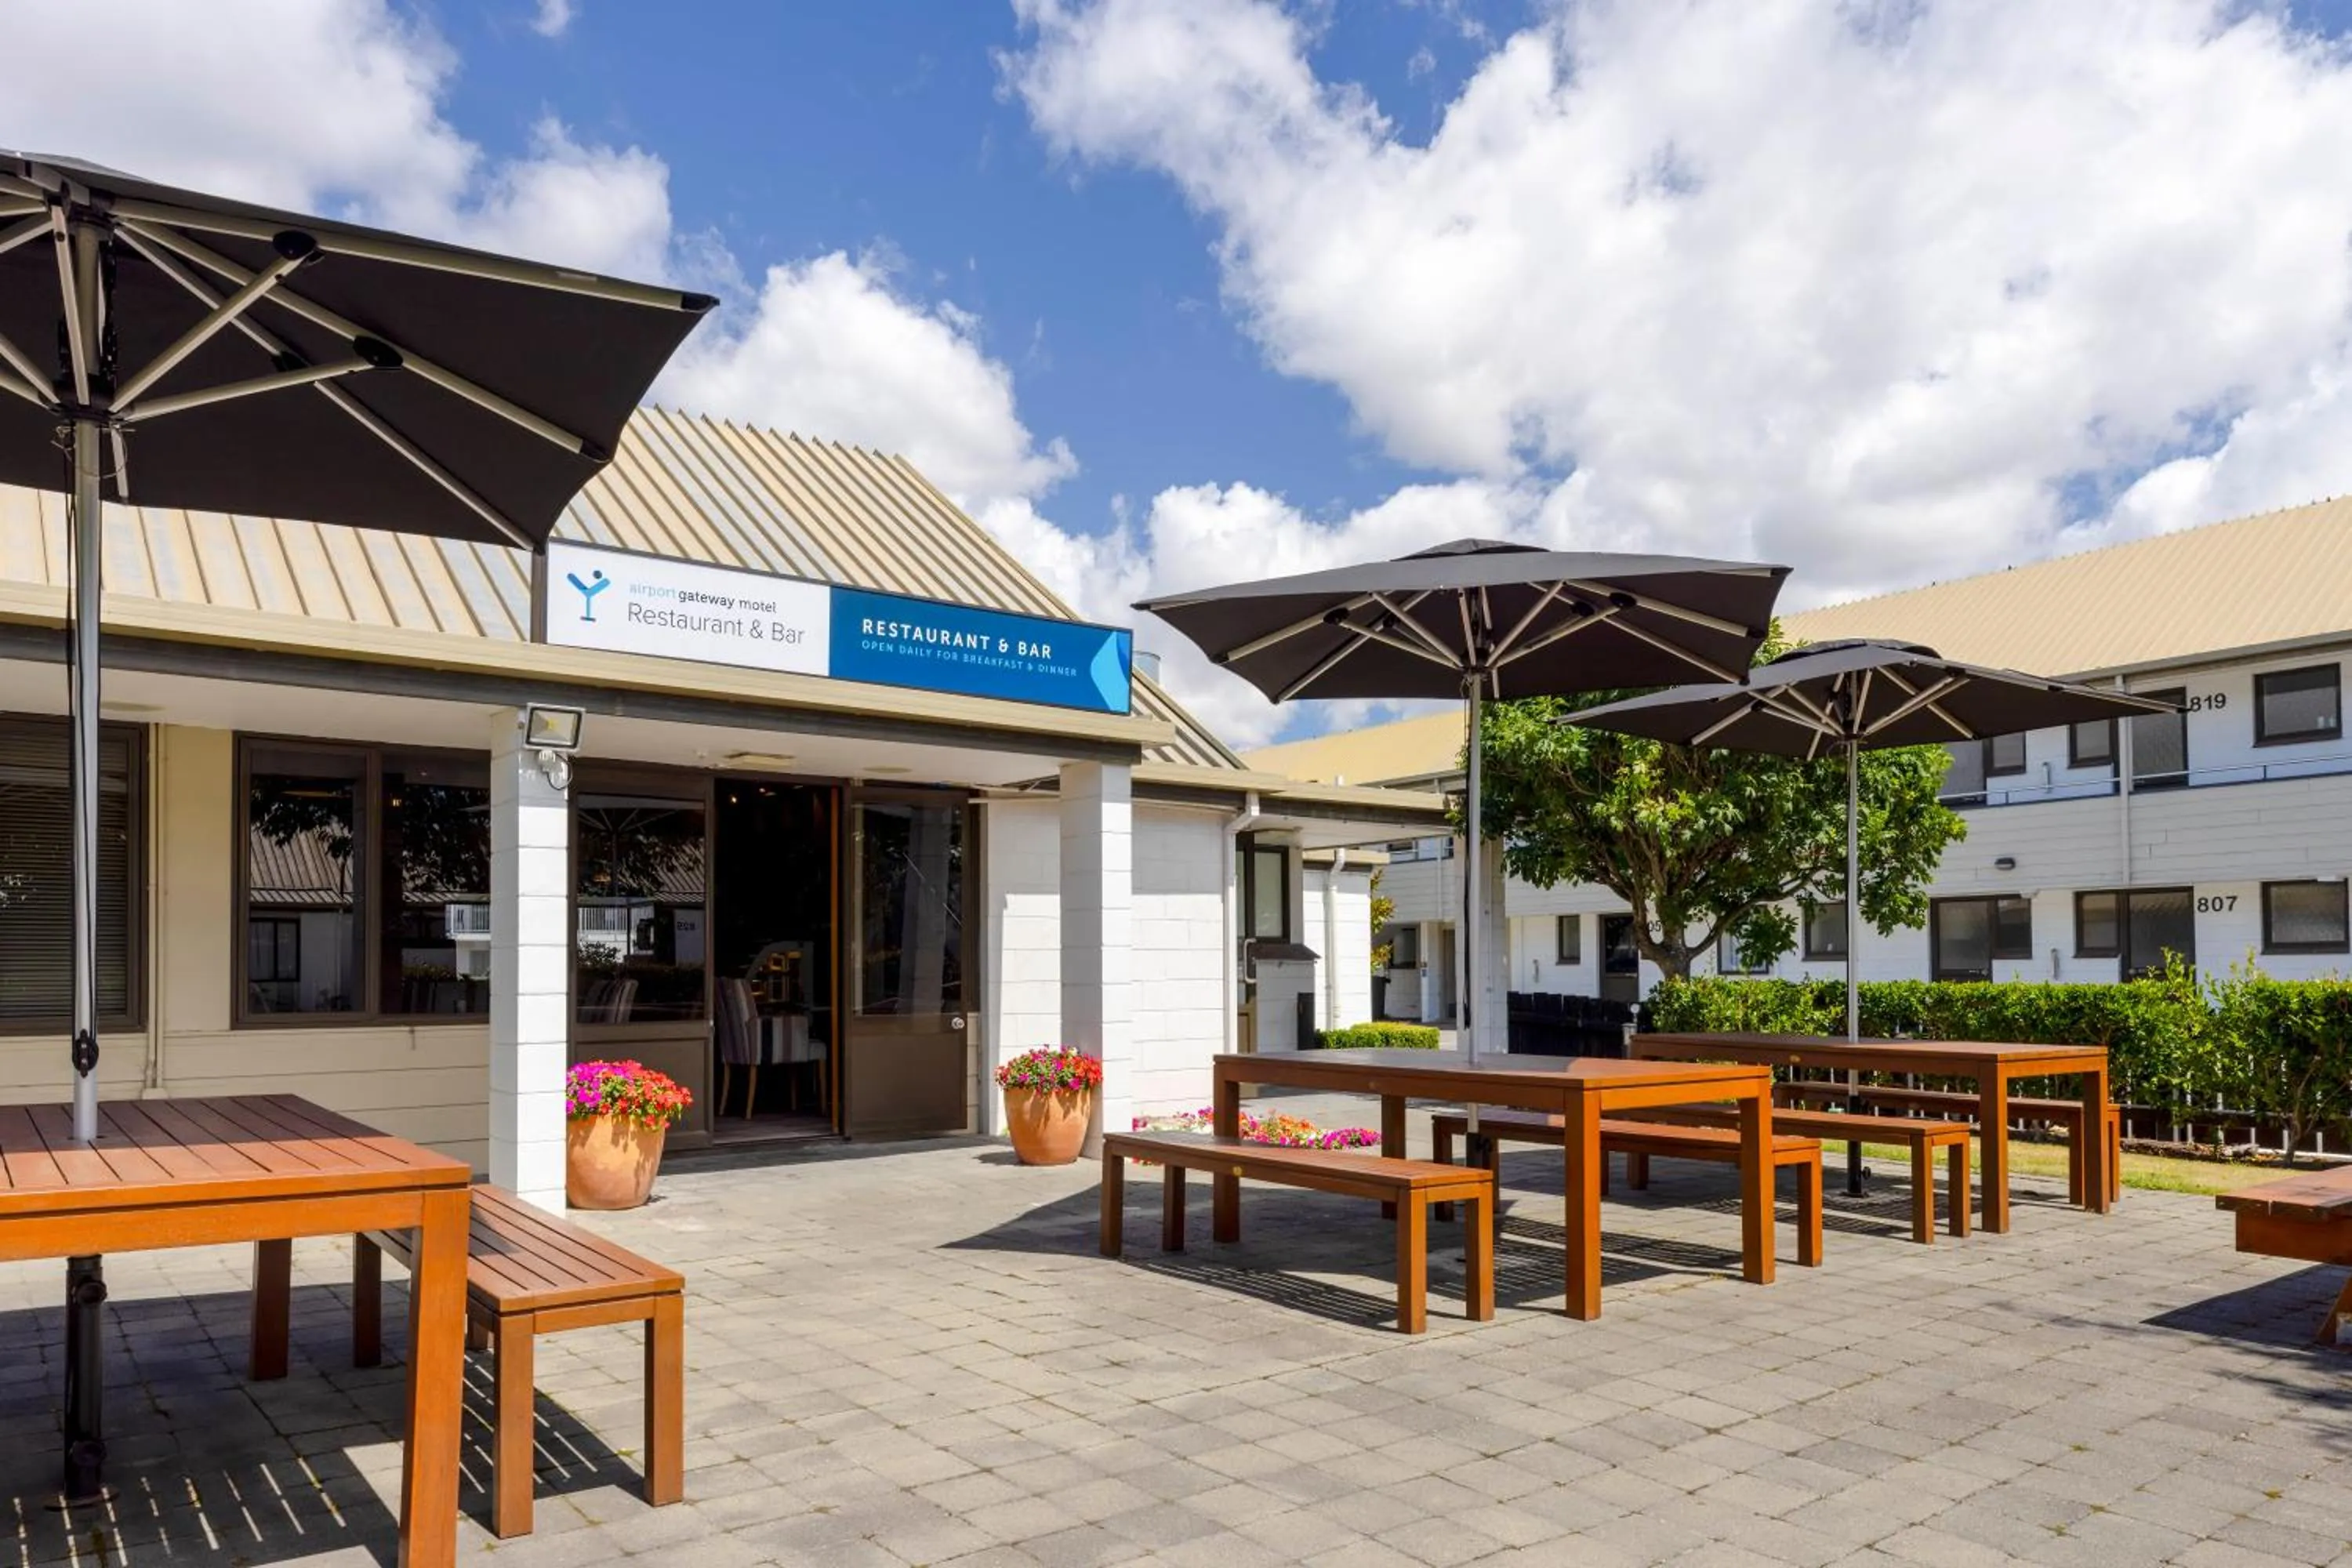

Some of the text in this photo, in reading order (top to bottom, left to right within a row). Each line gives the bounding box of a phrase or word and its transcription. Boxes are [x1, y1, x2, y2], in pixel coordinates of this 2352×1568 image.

[629, 583, 777, 614] airport gateway motel
[627, 602, 805, 644] Restaurant & Bar
[862, 619, 1051, 659] RESTAURANT & BAR
[862, 640, 894, 653] OPEN
[898, 644, 932, 658] DAILY
[937, 650, 958, 661] FOR
[963, 653, 1023, 670] BREAKFAST
[1037, 663, 1076, 676] DINNER
[2190, 692, 2227, 712] 819
[2197, 895, 2238, 913] 807
